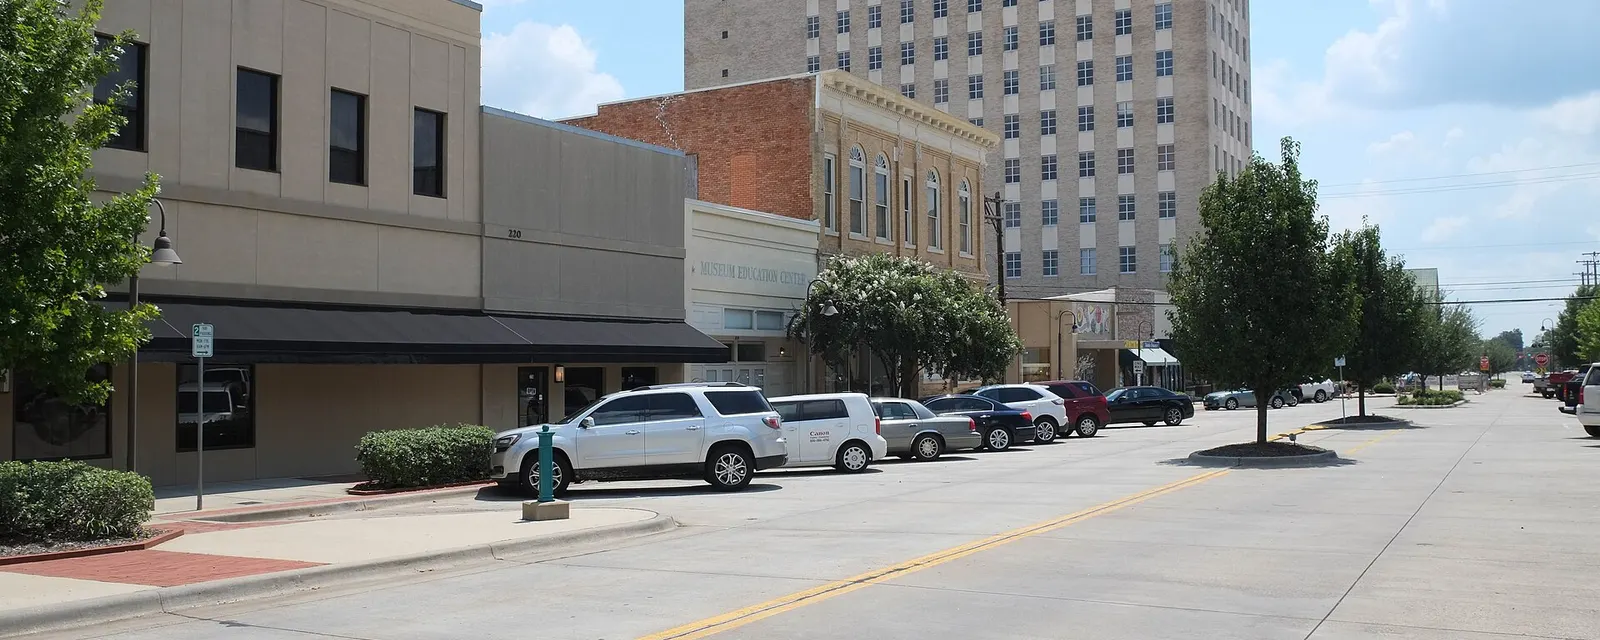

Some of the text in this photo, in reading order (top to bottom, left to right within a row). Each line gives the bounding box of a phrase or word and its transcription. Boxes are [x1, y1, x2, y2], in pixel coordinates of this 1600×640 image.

[508, 229, 521, 239] 220
[700, 261, 807, 286] MUSEUM EDUCATION CENTER
[194, 326, 199, 336] 2
